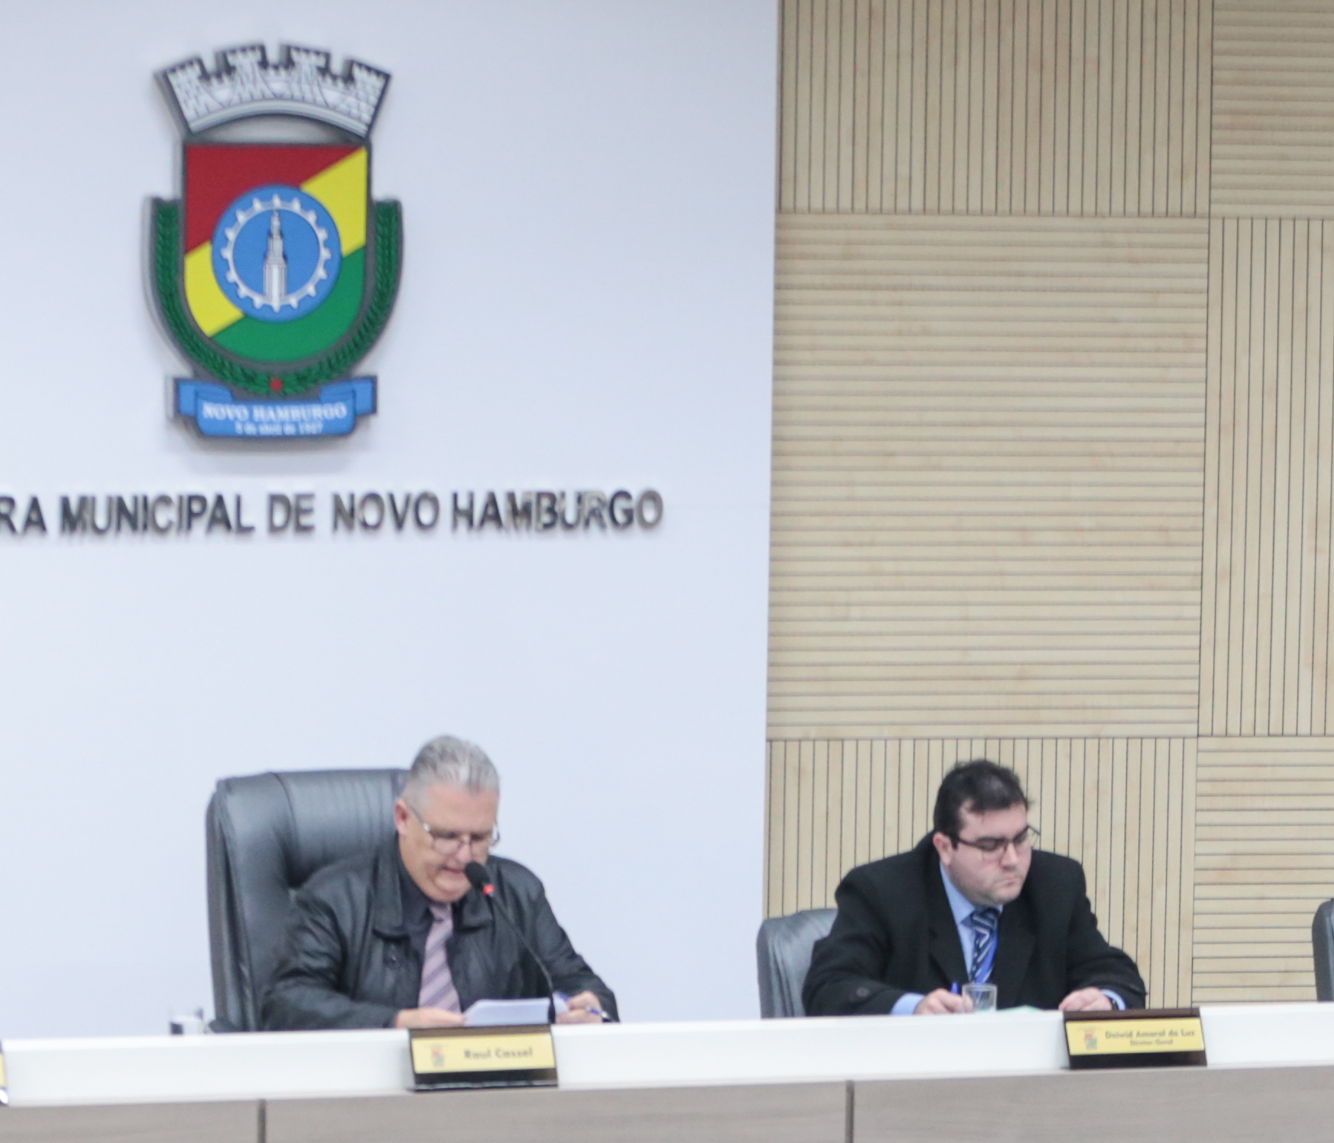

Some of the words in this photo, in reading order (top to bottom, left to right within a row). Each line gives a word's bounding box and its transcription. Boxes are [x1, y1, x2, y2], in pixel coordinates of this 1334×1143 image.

[202, 402, 250, 421] NOVO
[253, 401, 348, 422] HAMBURGO
[58, 493, 256, 535] MUNICIPAL
[268, 492, 316, 533] DE
[331, 490, 440, 534] NOVO
[451, 490, 665, 533] HAMBURGO
[464, 1049, 491, 1060] Raul
[495, 1047, 533, 1059] Cassel
